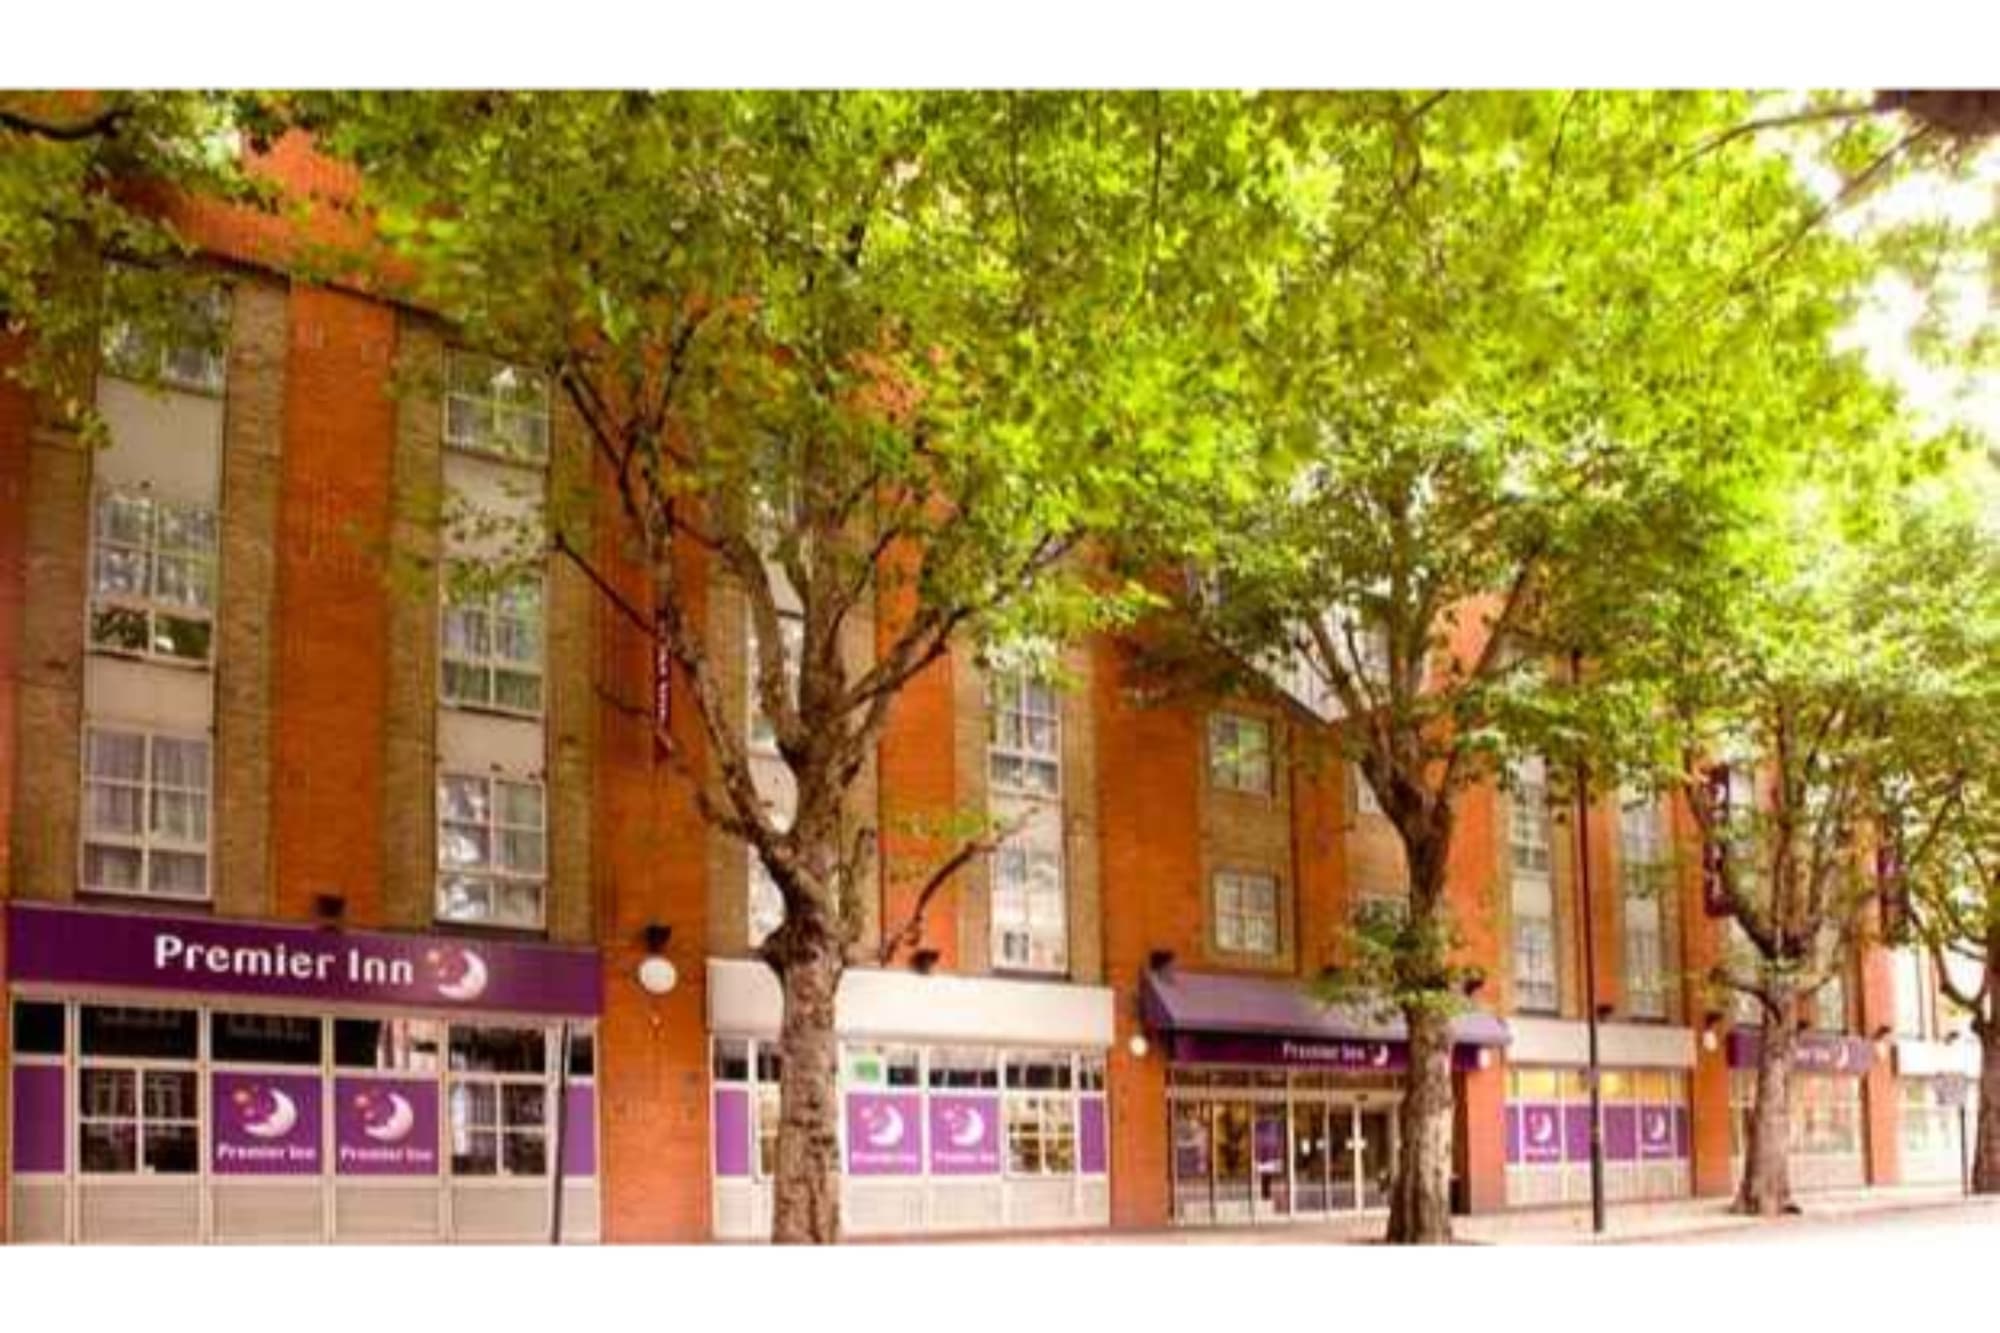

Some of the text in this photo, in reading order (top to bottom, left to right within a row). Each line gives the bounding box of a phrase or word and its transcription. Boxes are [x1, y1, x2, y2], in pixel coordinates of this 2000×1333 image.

[155, 934, 414, 985] Premier Inn
[217, 1143, 287, 1161] Premier
[341, 1146, 403, 1162] Premier
